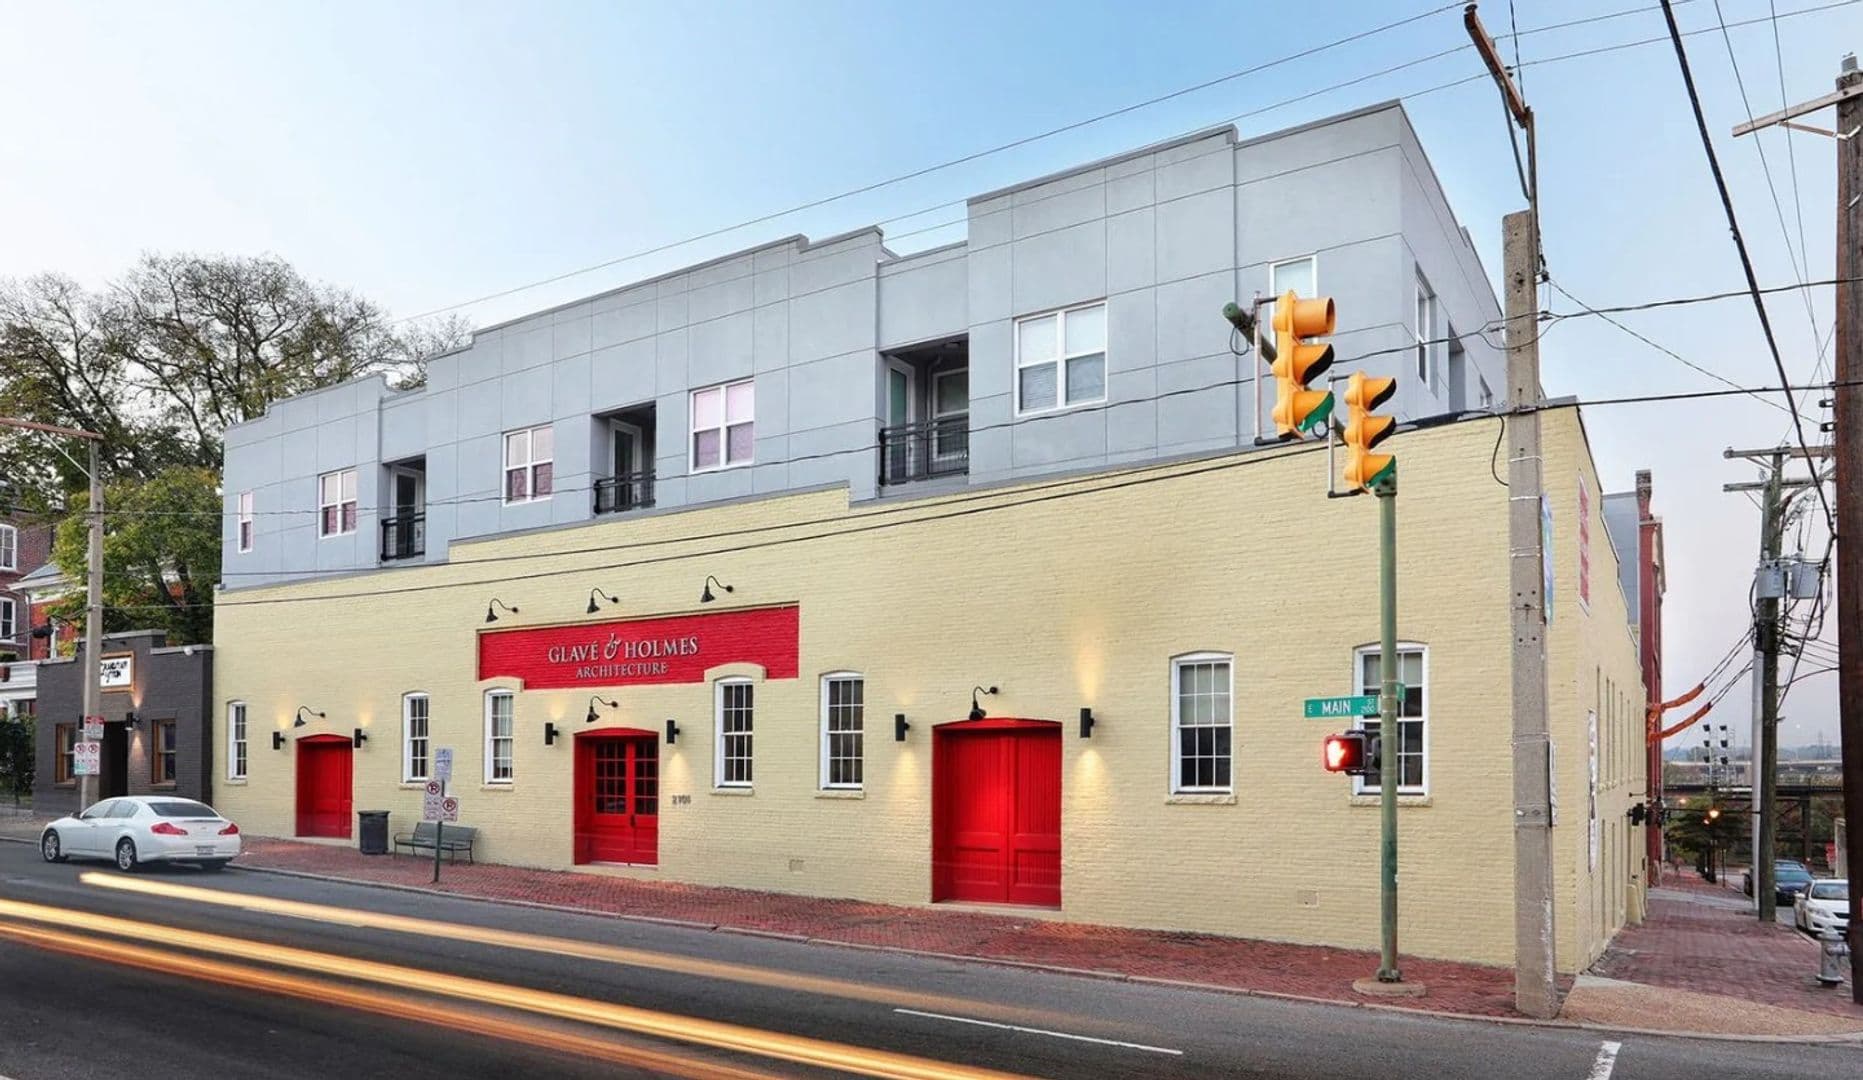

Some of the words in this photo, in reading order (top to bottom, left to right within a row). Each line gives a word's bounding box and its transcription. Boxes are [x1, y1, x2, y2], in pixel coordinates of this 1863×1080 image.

[548, 641, 599, 663] GLAVÉ
[604, 633, 621, 660] &
[625, 636, 699, 659] HOLMES
[576, 662, 668, 679] ARCHITECTURE
[1322, 700, 1351, 714] MAIN
